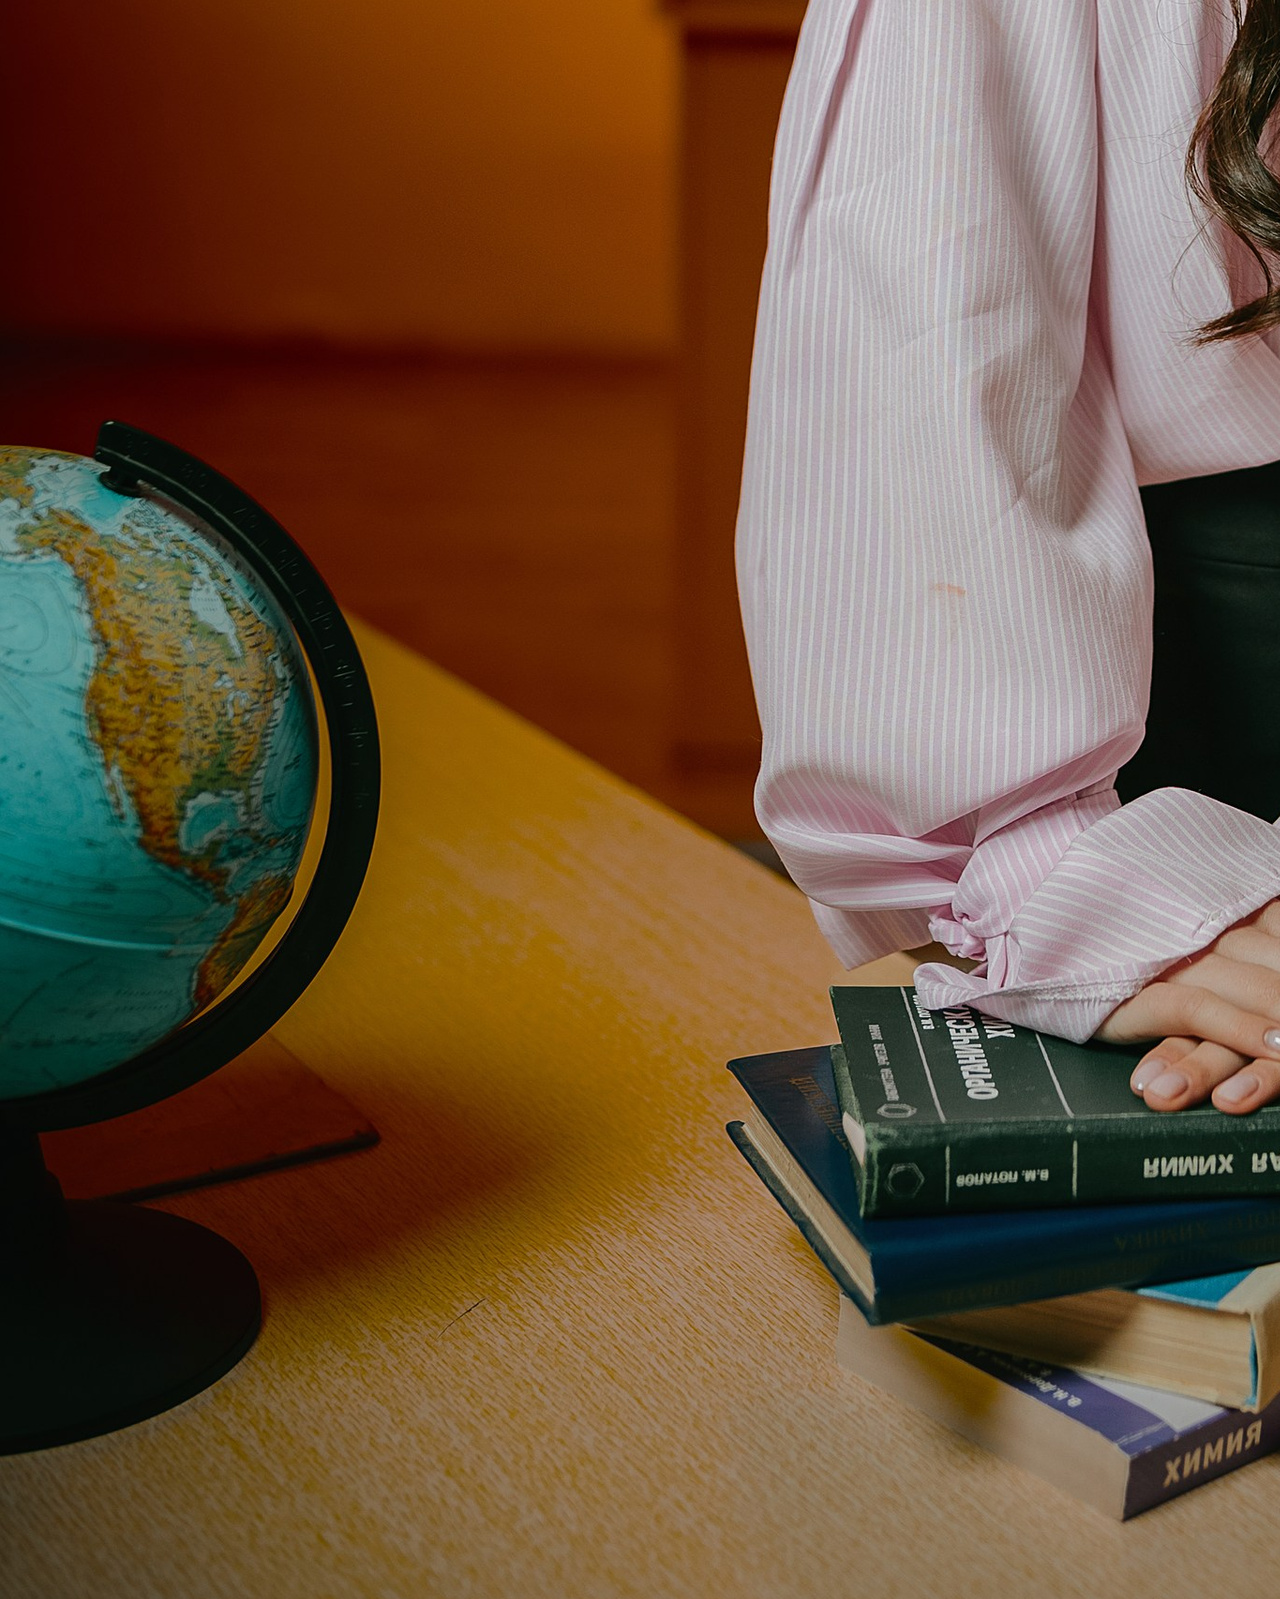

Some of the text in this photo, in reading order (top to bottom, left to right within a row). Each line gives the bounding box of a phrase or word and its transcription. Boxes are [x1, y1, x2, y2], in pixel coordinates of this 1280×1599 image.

[943, 1004, 999, 1100] ОРГАНИЧЕСКА
[956, 1168, 1049, 1187] В.М. ПОТАПОВ
[1143, 1153, 1234, 1178] ХИМИЯ
[1162, 1419, 1263, 1489] ХИМИЯ
